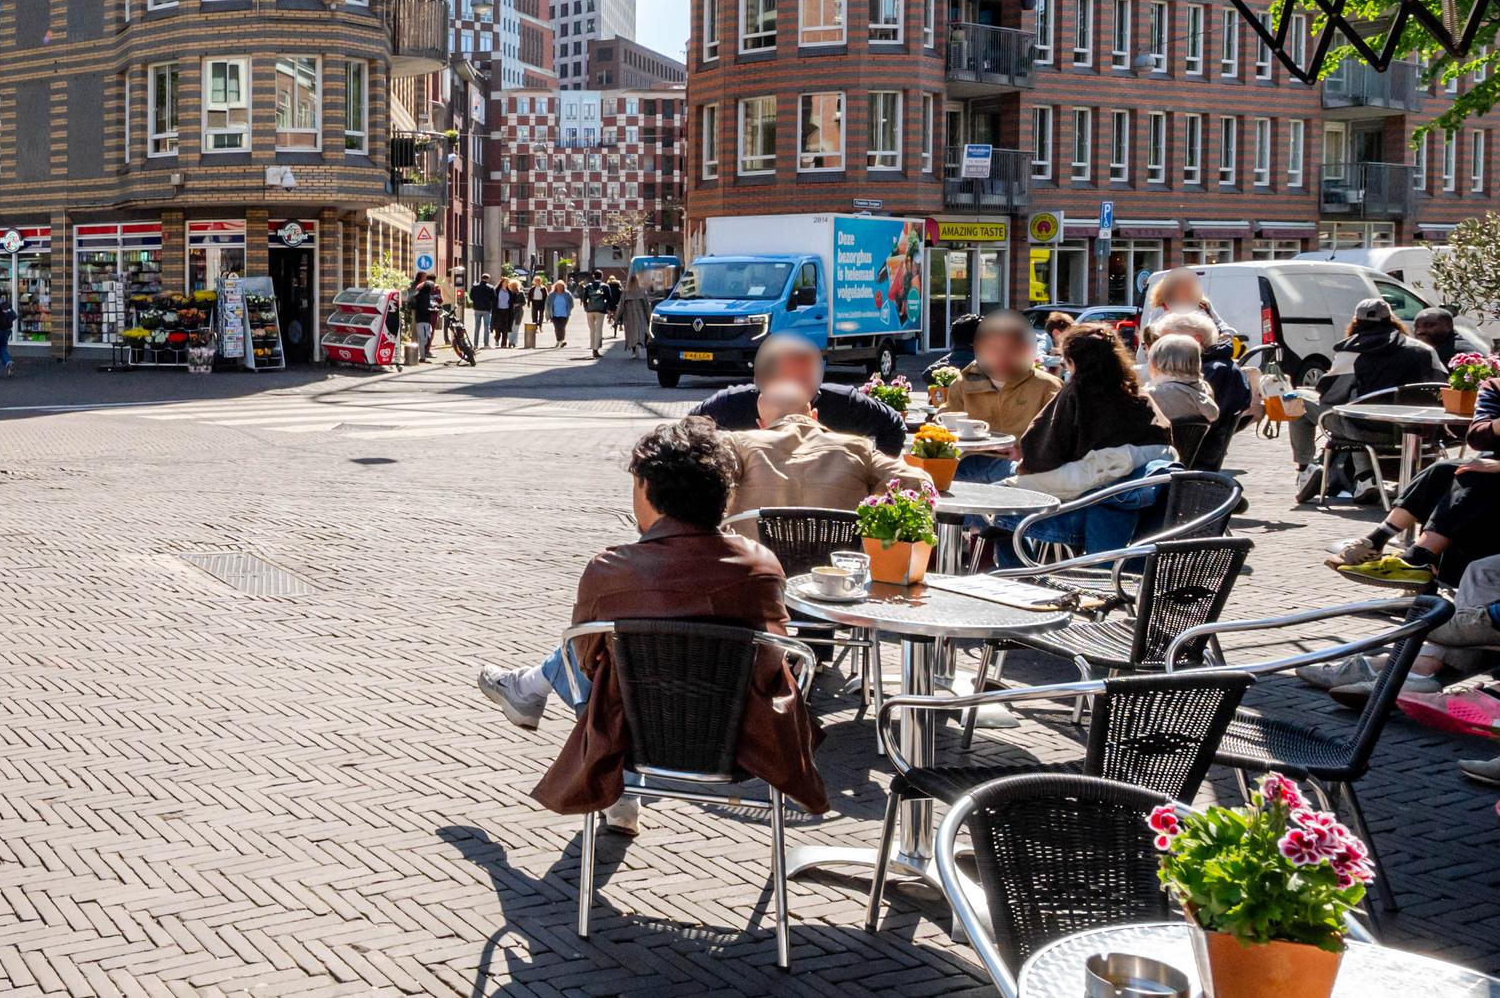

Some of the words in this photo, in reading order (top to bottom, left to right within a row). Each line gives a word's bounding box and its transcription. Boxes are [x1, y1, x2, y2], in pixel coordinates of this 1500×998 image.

[1103, 204, 1111, 218] P
[812, 216, 829, 224] 2814
[837, 231, 855, 245] Deze
[941, 226, 979, 237] AMAZING
[980, 227, 1004, 238] TASTE
[837, 248, 873, 266] bezorgbus
[837, 266, 844, 281] is
[844, 266, 875, 281] helemaal
[837, 284, 874, 302] volgeladen.
